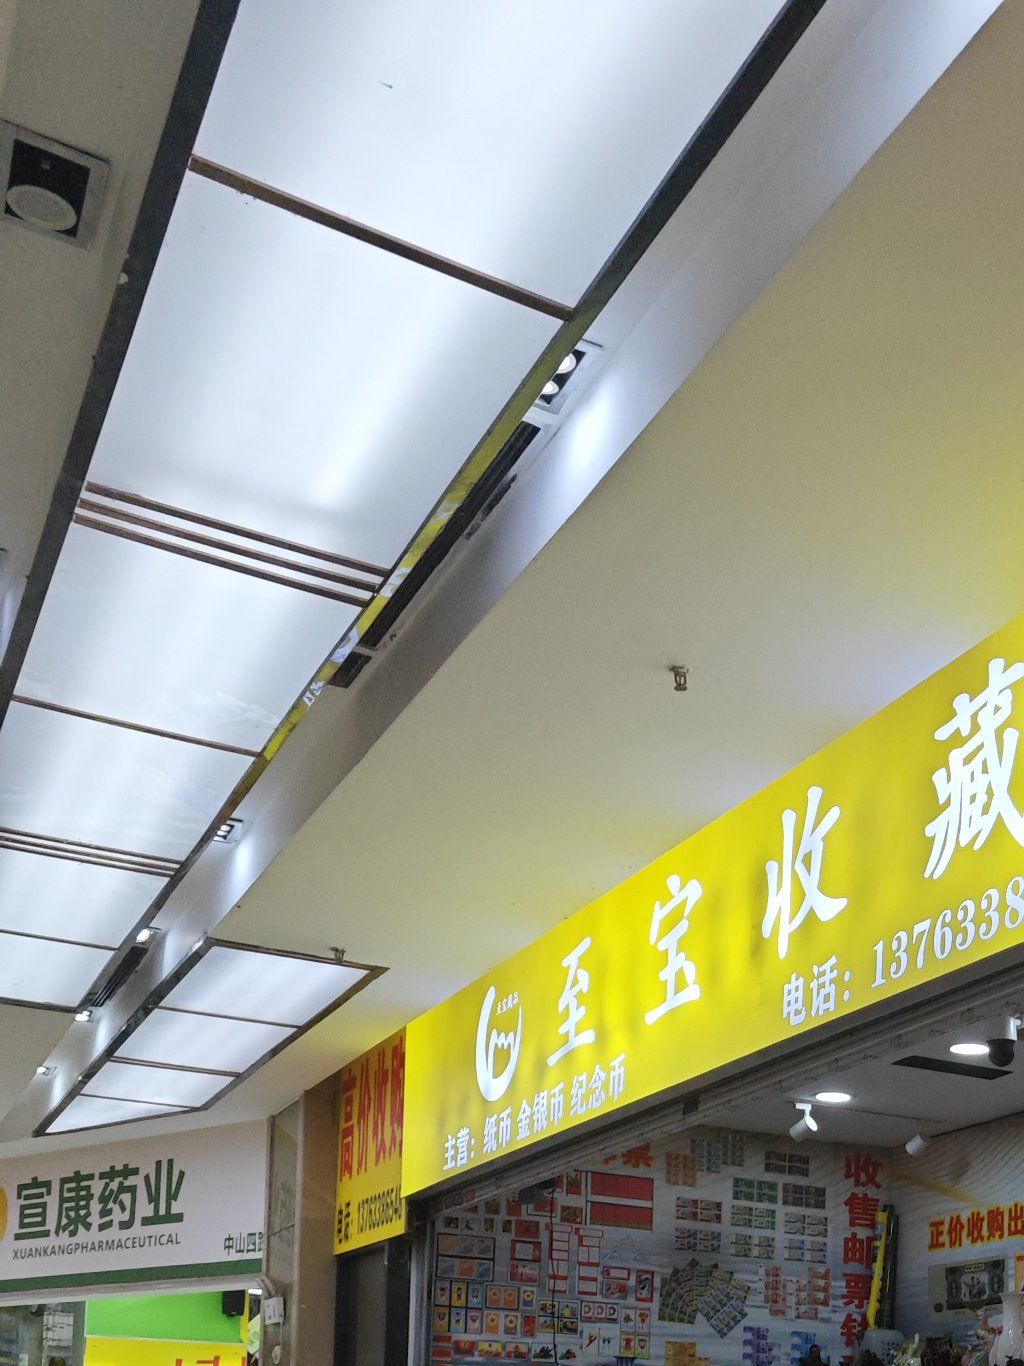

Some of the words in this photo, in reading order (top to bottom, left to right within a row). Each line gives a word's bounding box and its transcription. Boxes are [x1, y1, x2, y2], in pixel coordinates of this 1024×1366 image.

[781, 955, 851, 1027] 电话：
[340, 1036, 405, 1184] 高价收购
[483, 1105, 513, 1154] 纸币
[517, 1081, 565, 1141] 金银币
[570, 1053, 626, 1117] 纪念币
[13, 1158, 186, 1241] 宣康药业
[13, 1233, 181, 1260] XUANKANGPHARMACEUTICAL
